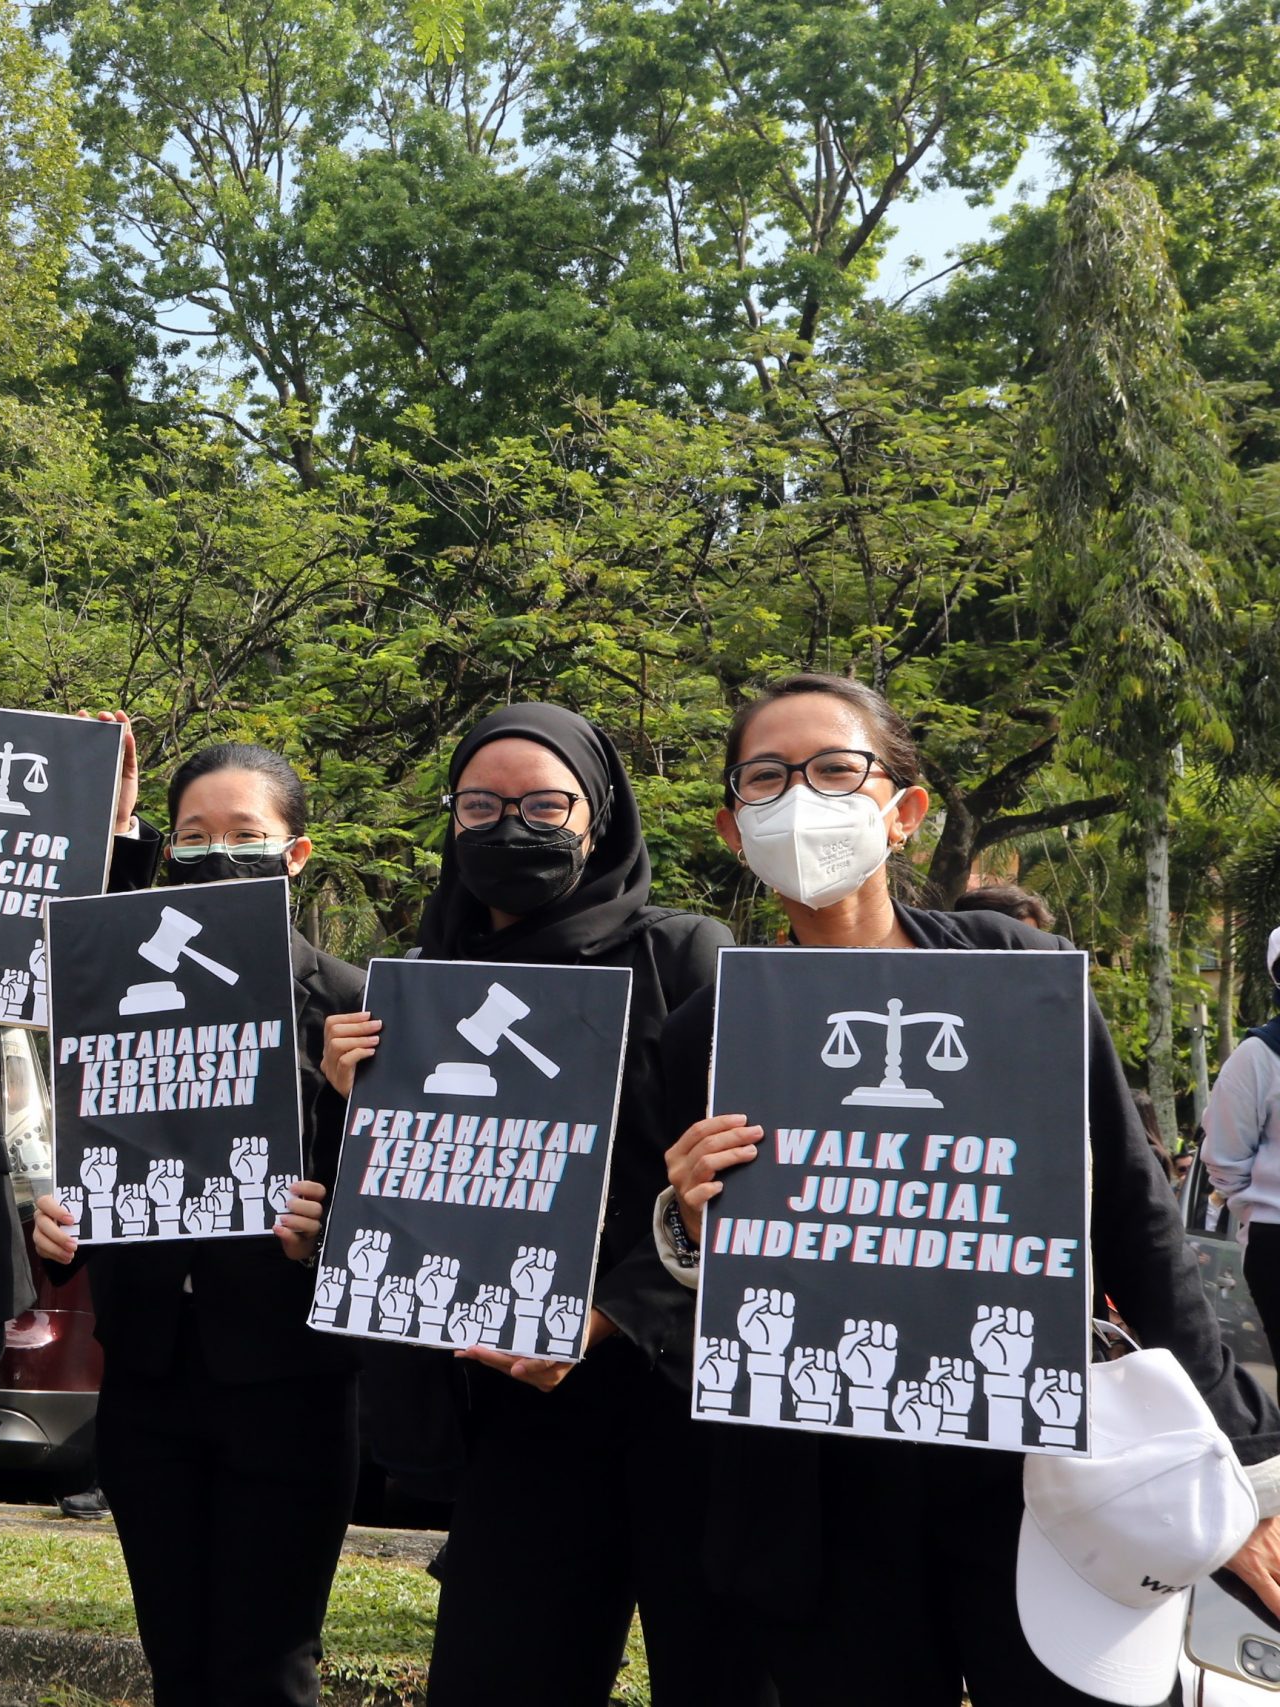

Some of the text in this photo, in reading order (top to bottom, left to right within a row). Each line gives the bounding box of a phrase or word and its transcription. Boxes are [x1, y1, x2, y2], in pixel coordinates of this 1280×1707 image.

[14, 832, 69, 860] FOR
[60, 1020, 281, 1064] PERTAHANKAN
[83, 1050, 259, 1091] KEBEBASAN
[80, 1079, 255, 1117] KEHAKIMAN
[350, 1107, 597, 1154] PERTAHANKAN
[775, 1129, 1017, 1175] WALK FOR
[368, 1136, 567, 1182] KEBEBASAN
[360, 1166, 556, 1212] KEHAKIMAN
[788, 1176, 1009, 1223] JUDICIAL
[713, 1218, 1078, 1277] INDEPENDENCE
